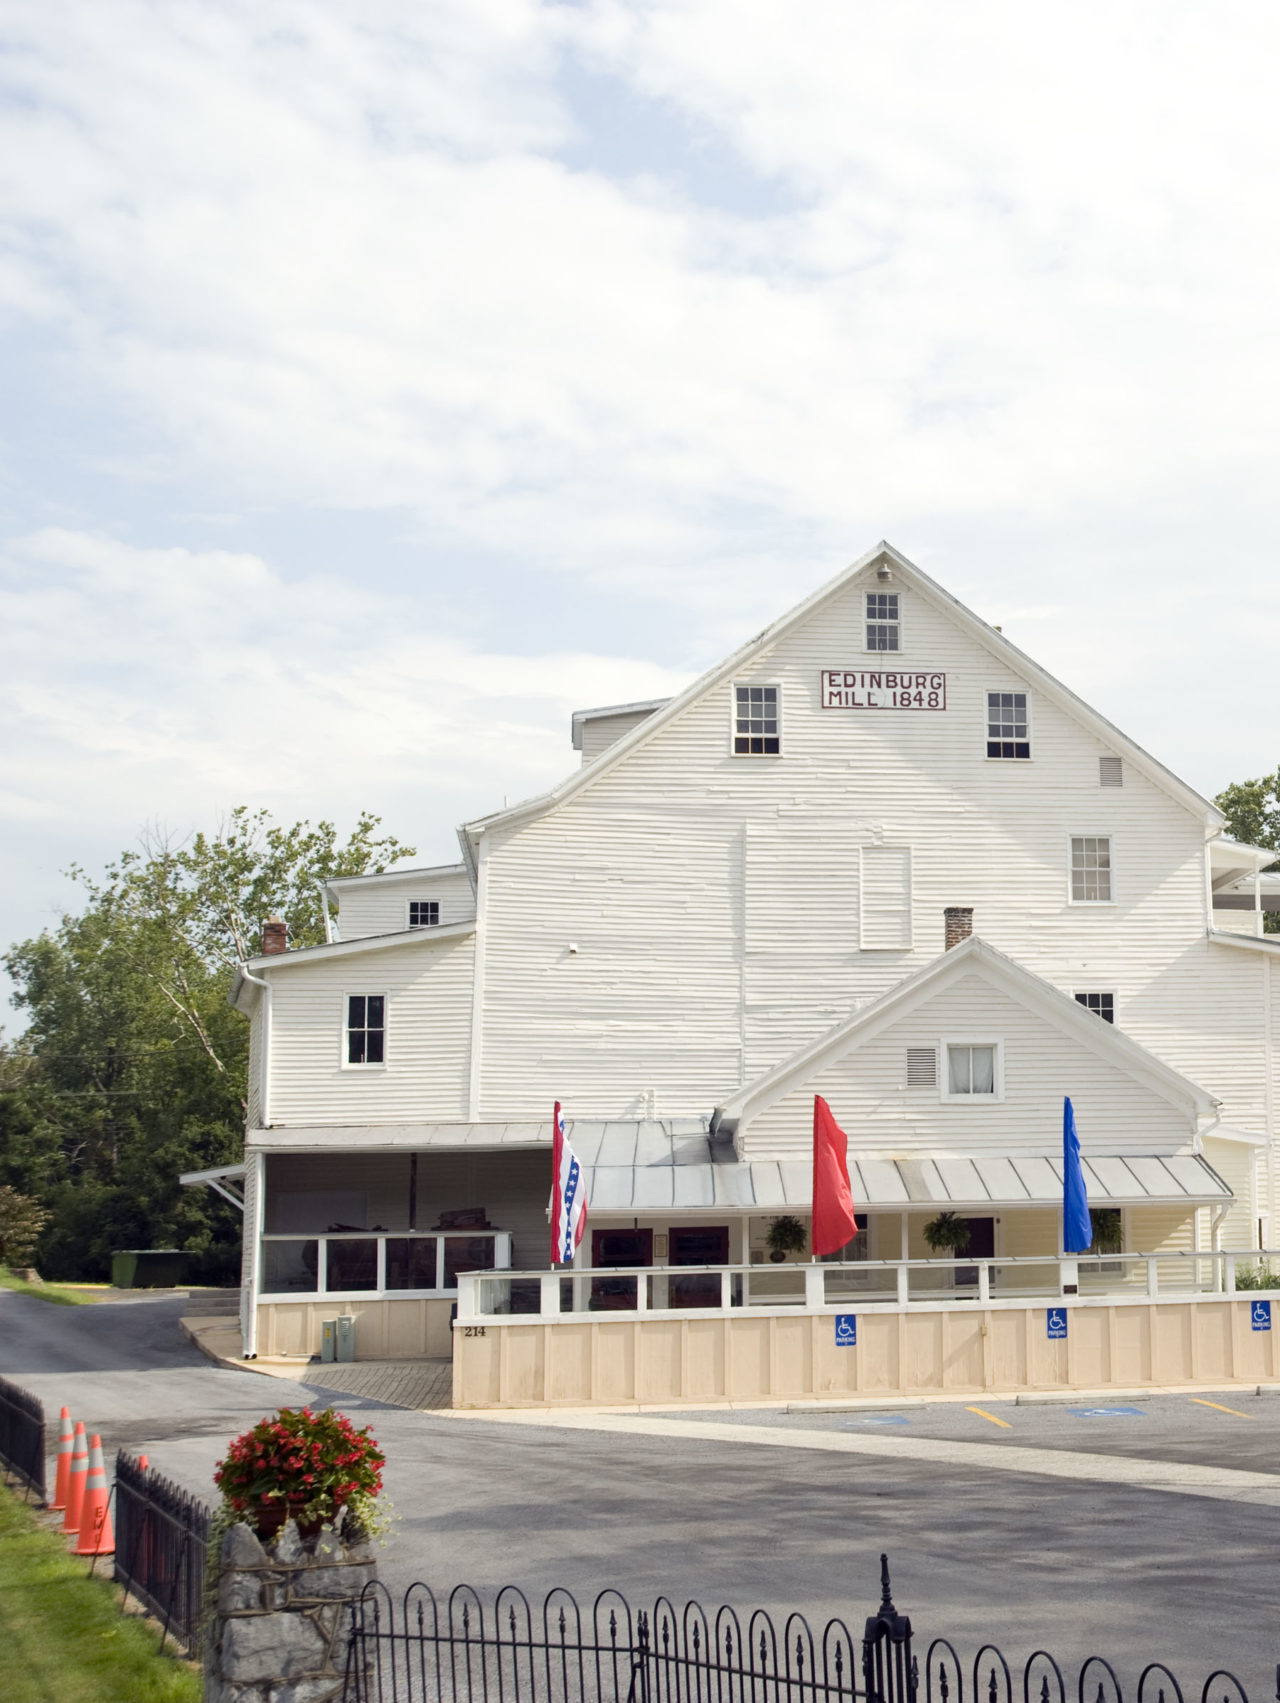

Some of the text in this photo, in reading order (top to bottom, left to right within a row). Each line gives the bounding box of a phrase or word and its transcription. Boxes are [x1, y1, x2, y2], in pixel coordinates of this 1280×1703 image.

[828, 672, 942, 690] EDINBURG
[828, 691, 939, 707] MILL 1848
[464, 1326, 486, 1337] 214
